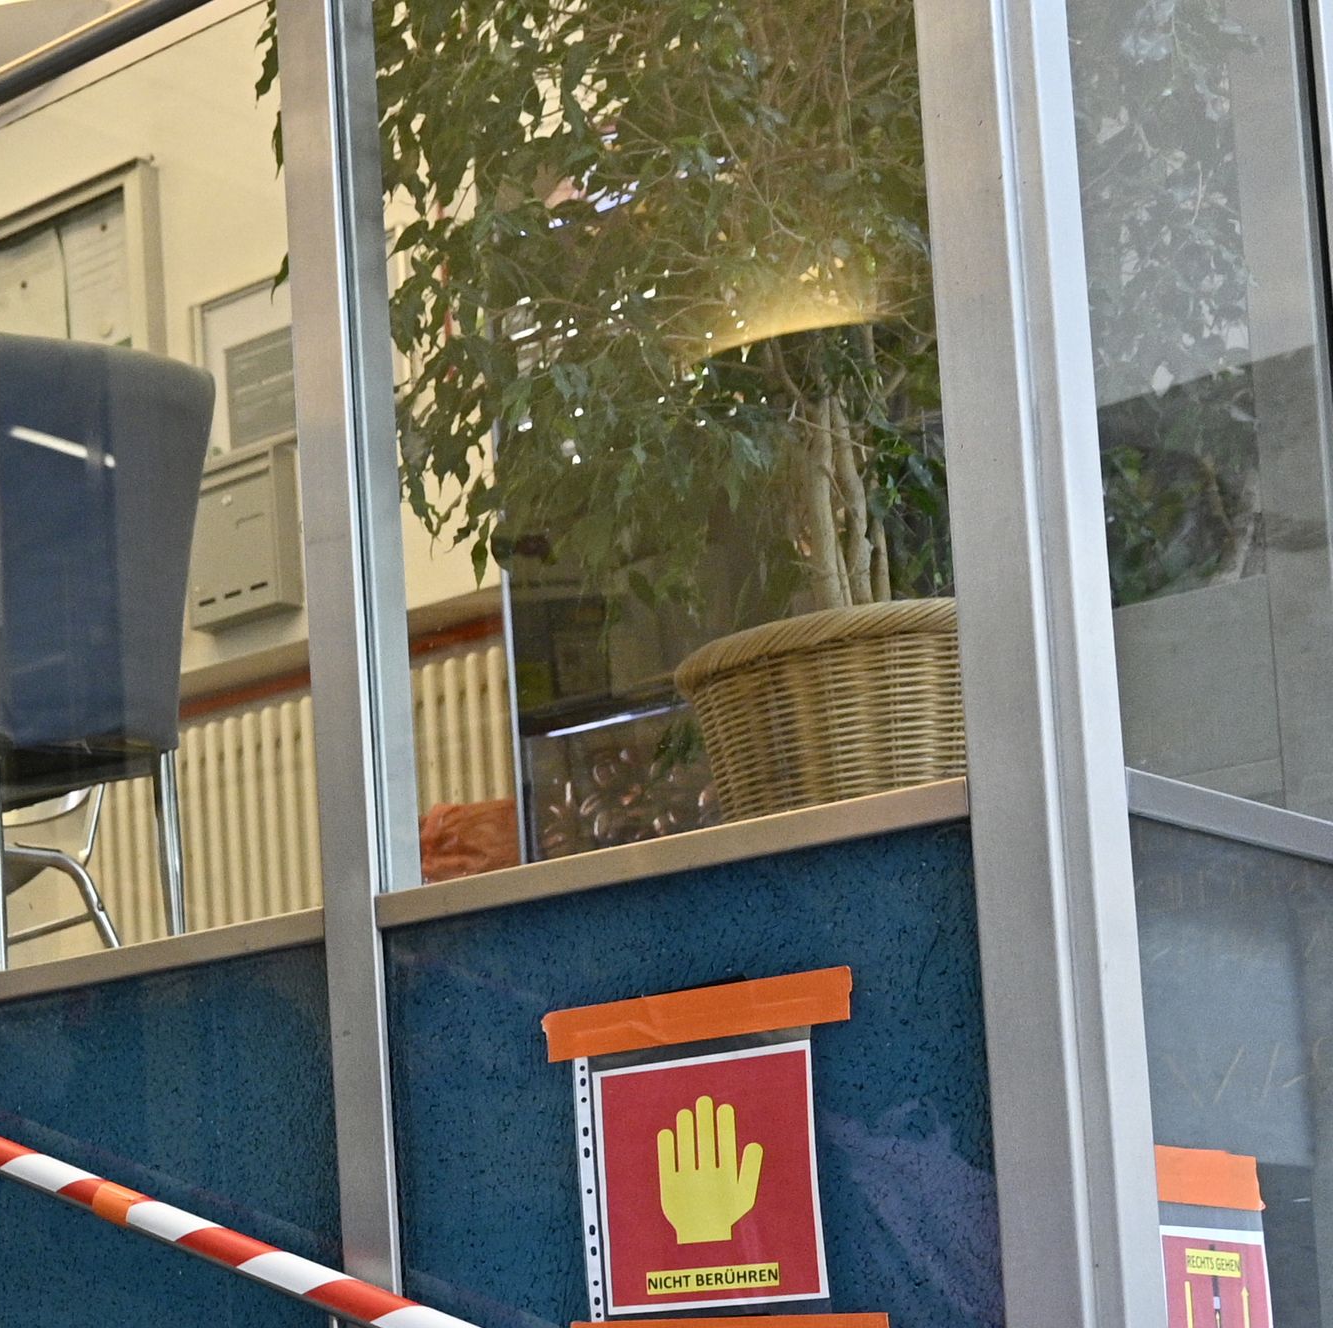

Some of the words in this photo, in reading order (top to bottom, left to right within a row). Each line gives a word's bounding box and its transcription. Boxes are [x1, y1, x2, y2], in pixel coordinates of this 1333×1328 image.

[1186, 1255, 1214, 1270] RECHTS
[1216, 1257, 1241, 1273] GEHEN
[647, 1275, 691, 1291] NICHT
[695, 1268, 779, 1287] BERÜHREN
